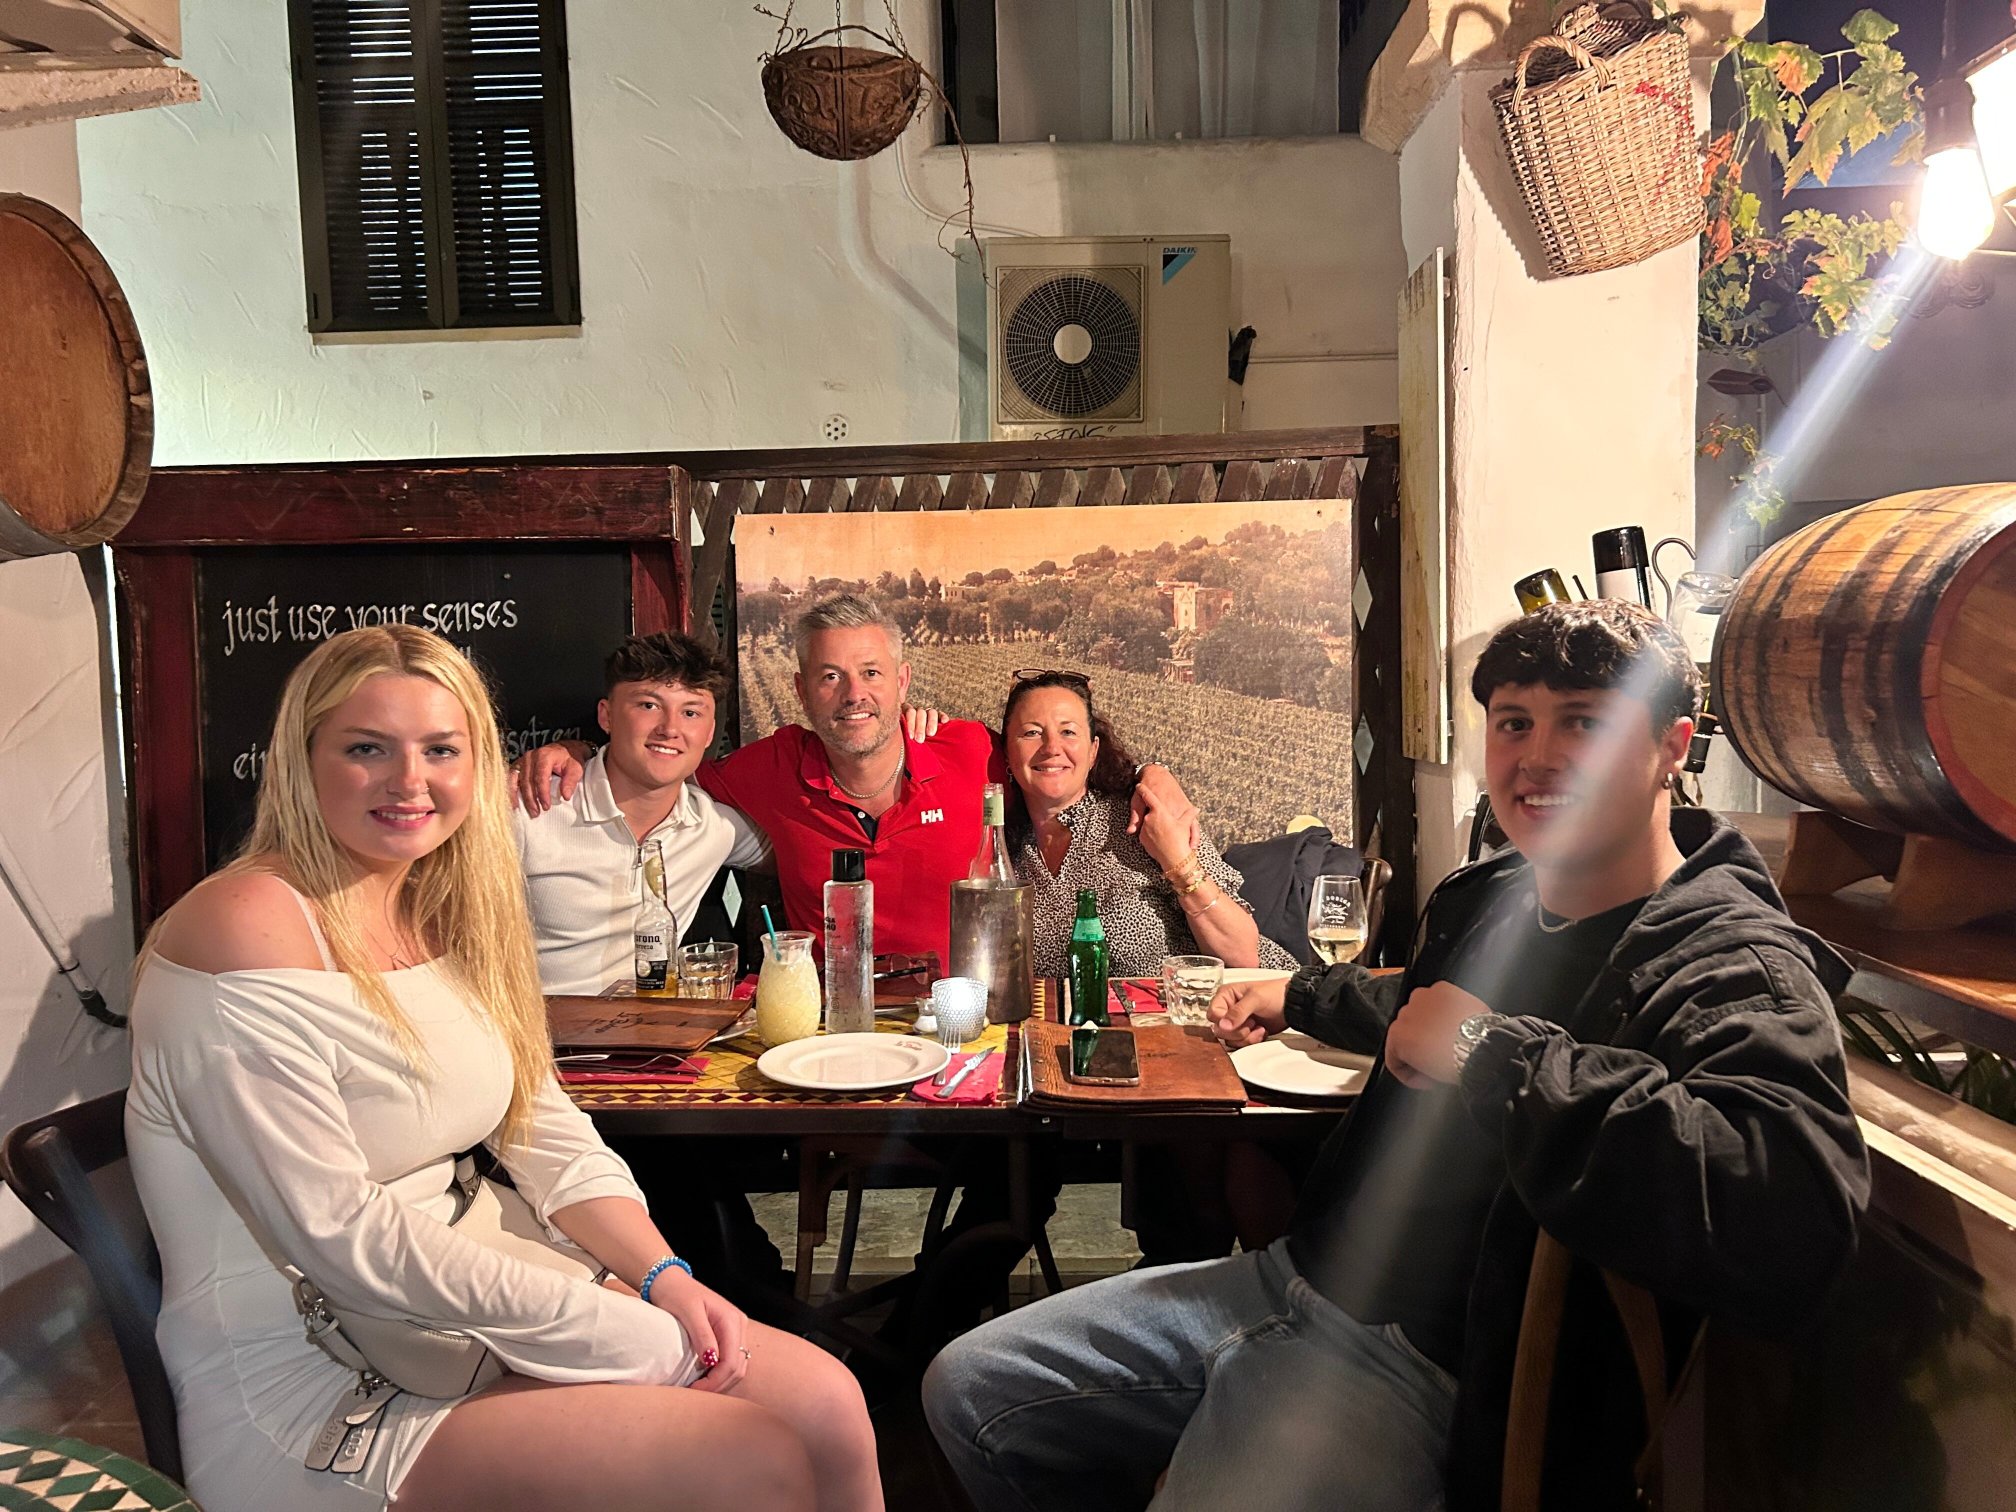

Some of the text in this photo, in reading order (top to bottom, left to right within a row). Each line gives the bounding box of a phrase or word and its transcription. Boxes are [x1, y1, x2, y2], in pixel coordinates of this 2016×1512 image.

[222, 595, 519, 657] just use your senses
[920, 808, 944, 825] HH
[634, 934, 661, 943] orona
